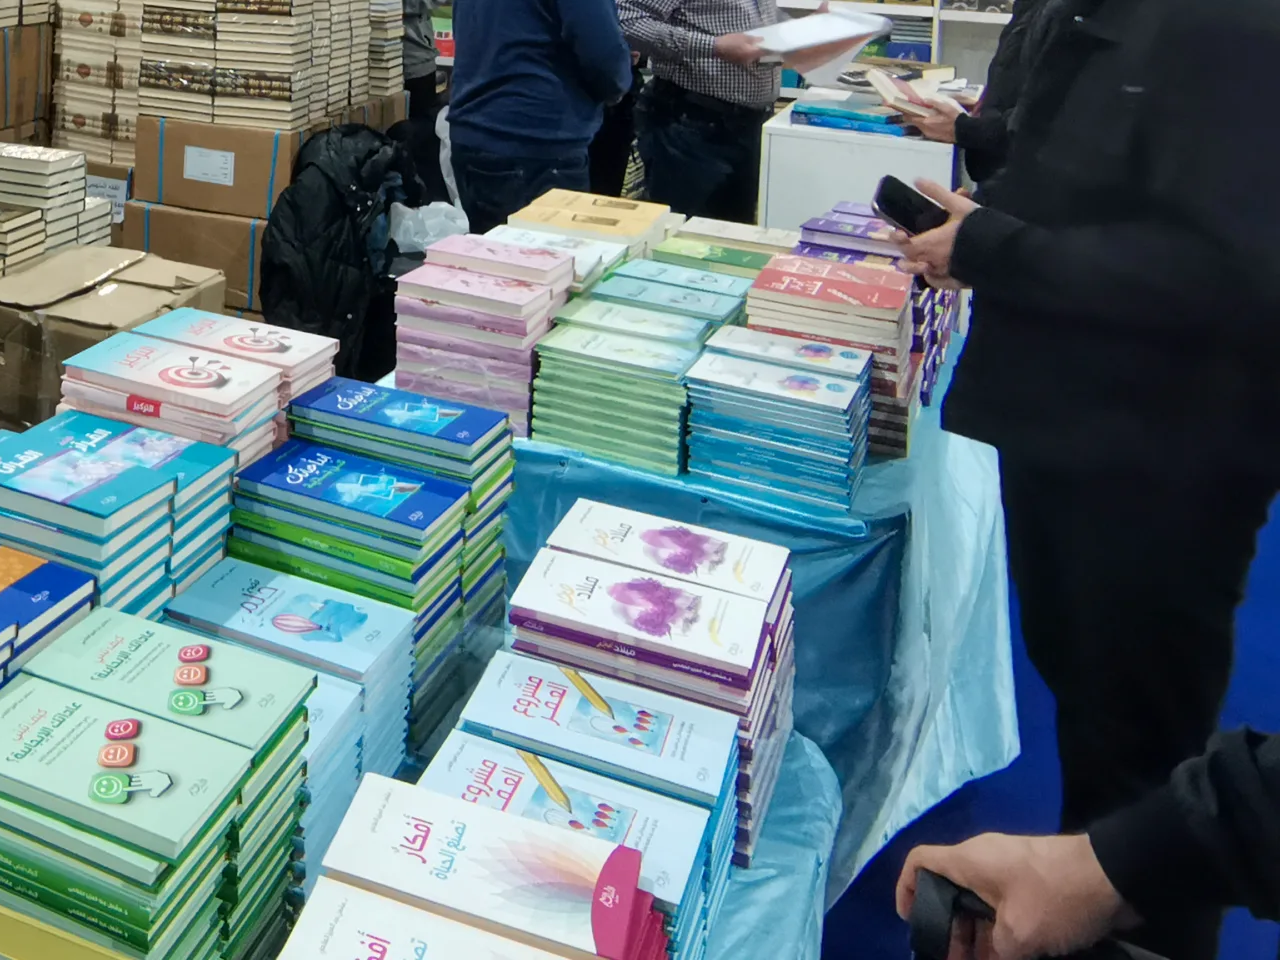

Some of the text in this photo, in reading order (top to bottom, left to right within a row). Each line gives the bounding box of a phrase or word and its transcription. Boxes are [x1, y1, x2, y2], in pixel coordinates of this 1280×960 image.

[52, 702, 82, 729] عاداتك
[513, 675, 543, 718] مشروع
[541, 681, 569, 727] العمر
[495, 767, 525, 812] العم
[400, 813, 433, 864] أفكار
[429, 820, 467, 880] تصنع الحياة
